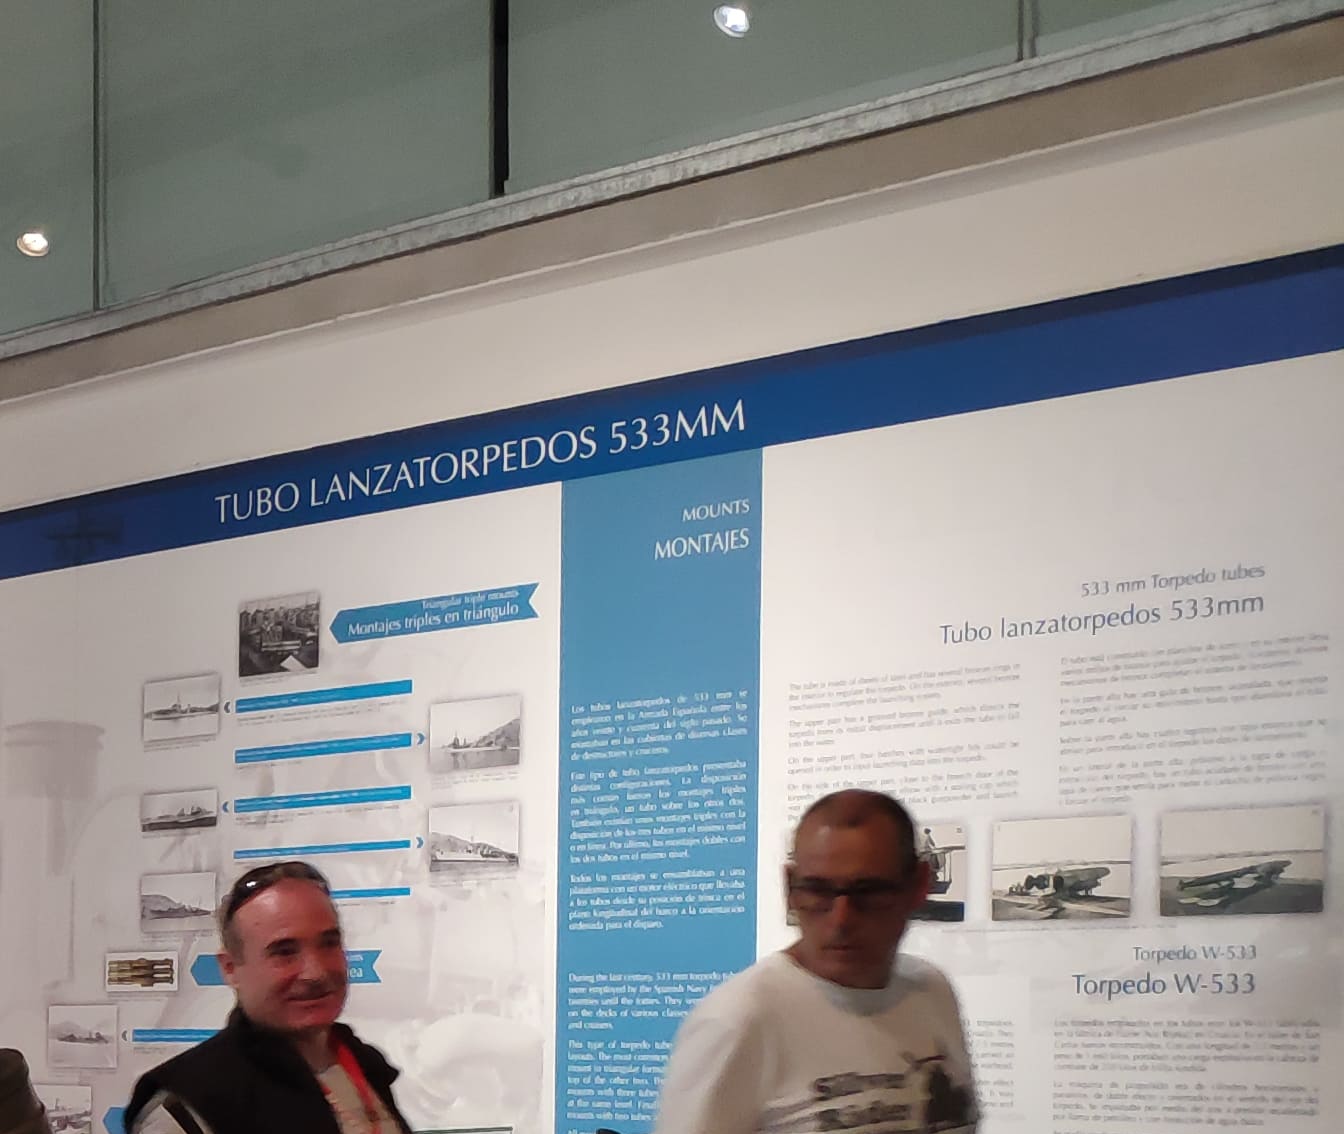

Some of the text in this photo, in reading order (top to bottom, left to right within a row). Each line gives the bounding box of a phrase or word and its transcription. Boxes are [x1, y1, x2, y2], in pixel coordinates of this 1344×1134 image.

[215, 399, 746, 524] TUBO LANZATORPEDOS 533MM
[681, 498, 751, 523] MOUNTS
[653, 528, 750, 561] MONTAJES
[1081, 563, 1266, 597] 533 mm Torpedo tubes
[348, 602, 518, 637] Montajes triples en triángulo
[940, 595, 1264, 644] Tubo lanzatorpedos 533mm
[1133, 945, 1256, 964] Torpedo W-533
[1072, 972, 1256, 1001] Torpedo W-533
